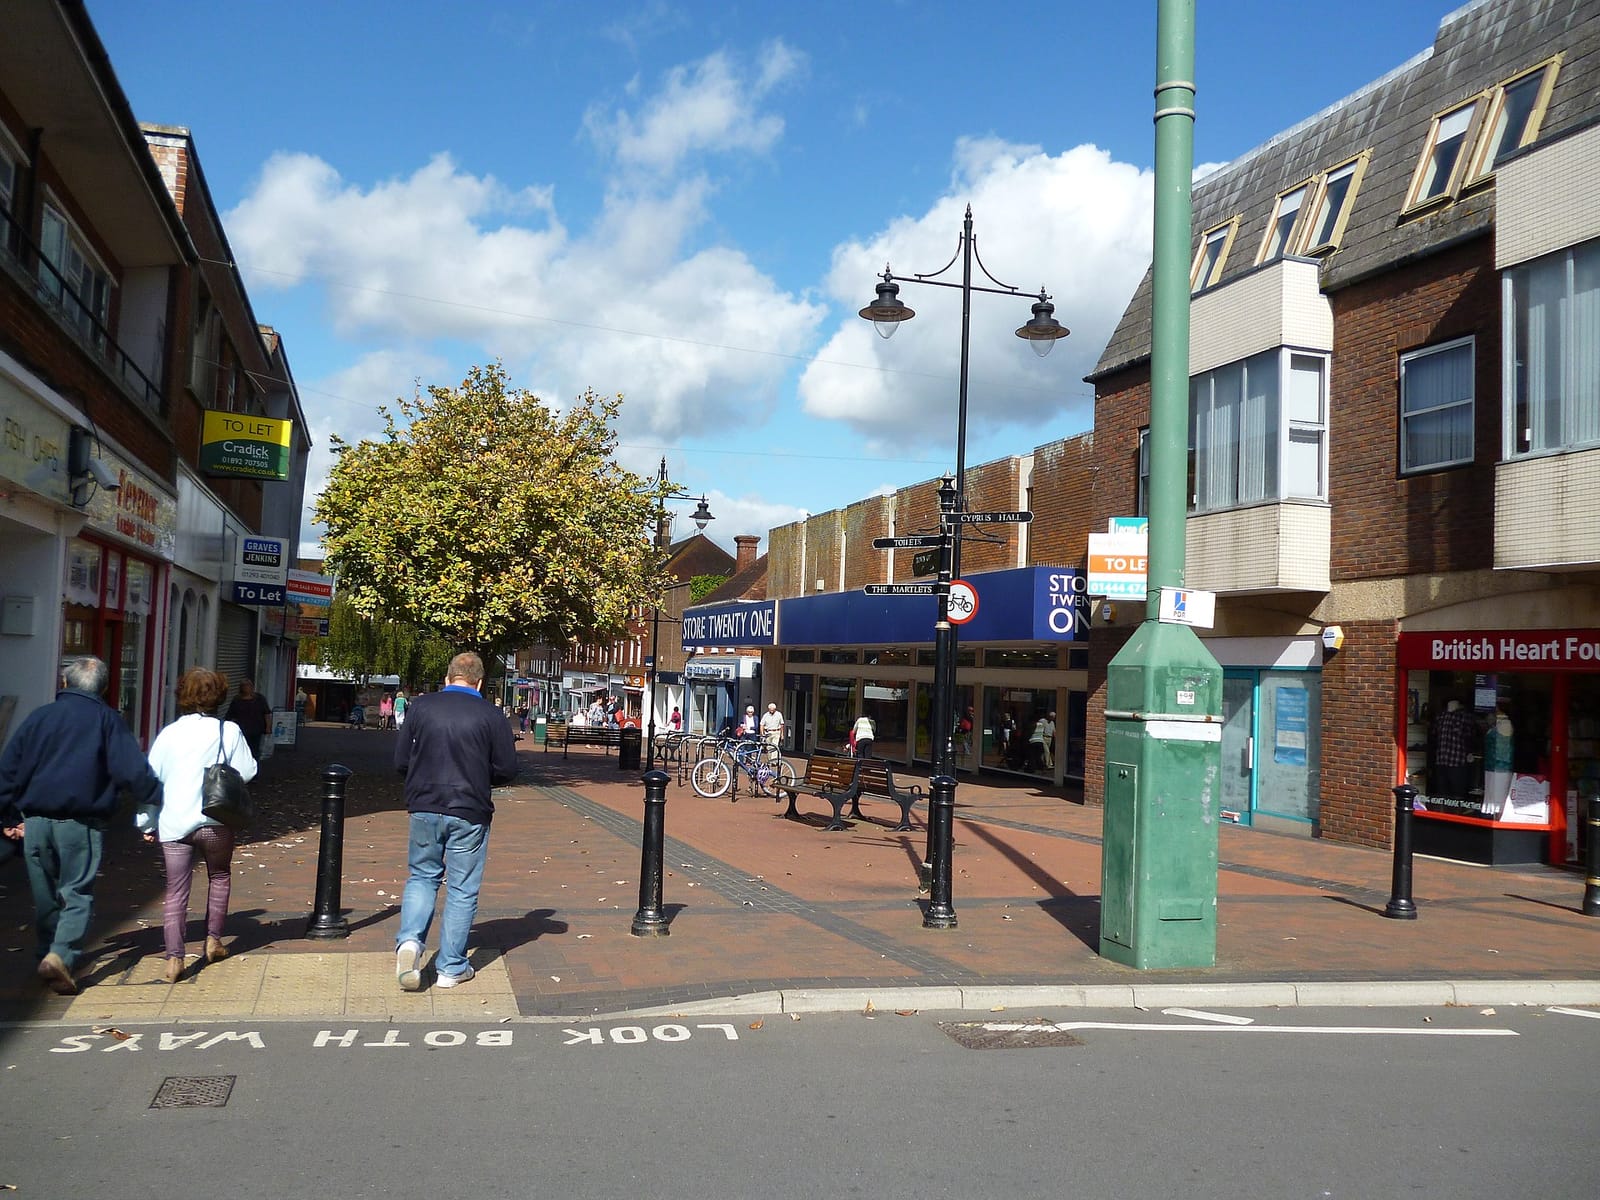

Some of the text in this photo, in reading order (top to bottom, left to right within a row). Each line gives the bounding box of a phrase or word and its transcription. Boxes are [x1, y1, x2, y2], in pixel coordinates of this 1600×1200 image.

[222, 419, 274, 437] TO LET
[222, 441, 269, 457] Cradick
[222, 457, 243, 465] 01892
[960, 513, 1022, 522] CYPRUS HALL
[246, 541, 278, 553] GRAVES
[894, 538, 922, 547] TOILETS
[245, 553, 278, 564] JENKINS
[1105, 558, 1147, 571] TO LE
[238, 586, 256, 599] To
[260, 588, 281, 602] Let
[871, 585, 933, 594] THE MARTLETS
[682, 608, 773, 640] STORE TWENTY ONE
[1432, 638, 1495, 660] British
[1499, 638, 1560, 660] Heart
[48, 1023, 739, 1055] LOOK BOTH WAYS
